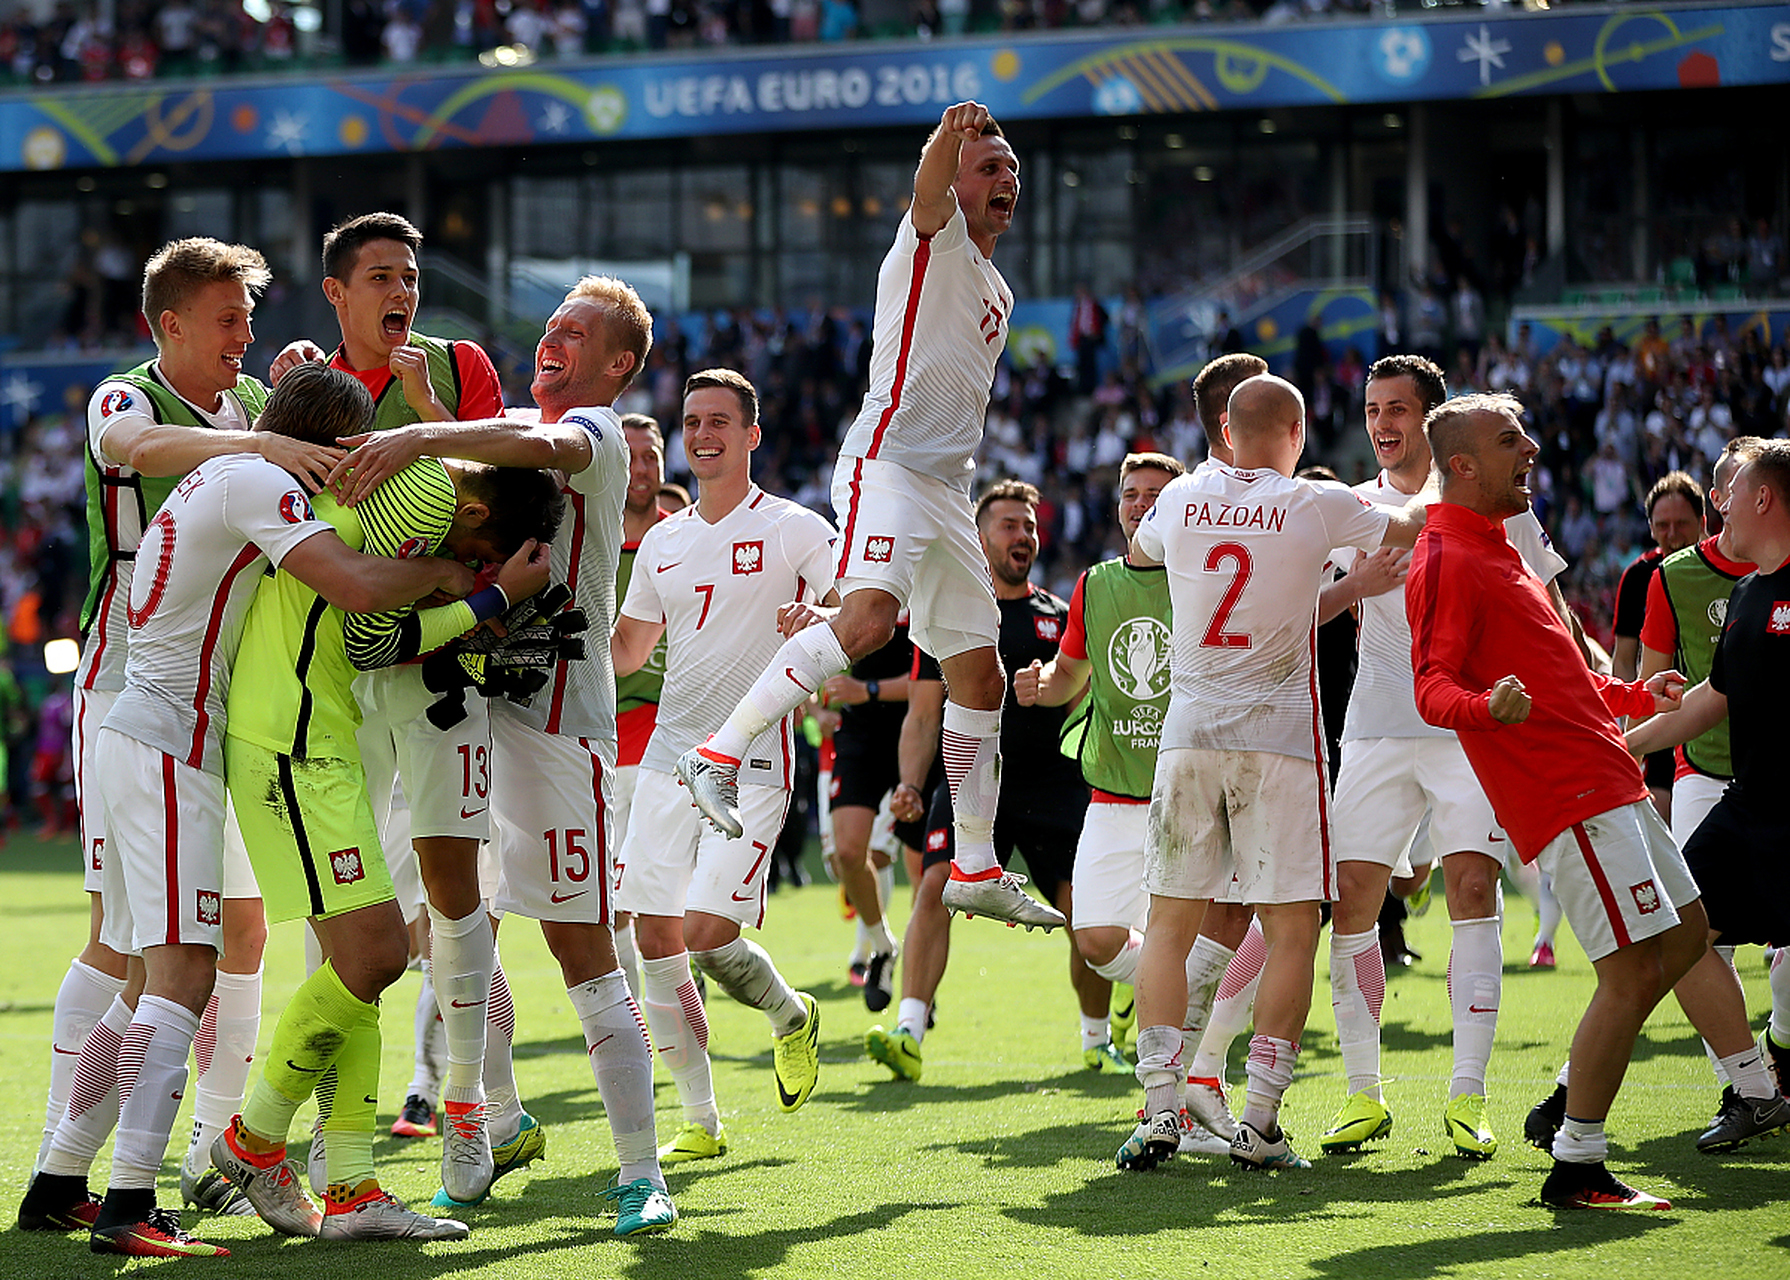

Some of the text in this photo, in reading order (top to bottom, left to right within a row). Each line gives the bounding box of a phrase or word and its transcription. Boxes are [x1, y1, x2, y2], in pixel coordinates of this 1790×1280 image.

[644, 61, 982, 118] UEFA EURO 2016
[1184, 502, 1287, 532] PAZDAN
[694, 584, 715, 630] 7
[1200, 541, 1254, 649] 2
[457, 653, 486, 685] adidas
[1131, 707, 1161, 720] UEFA
[457, 744, 488, 798] 13
[543, 828, 589, 882] 15
[742, 840, 768, 885] 7
